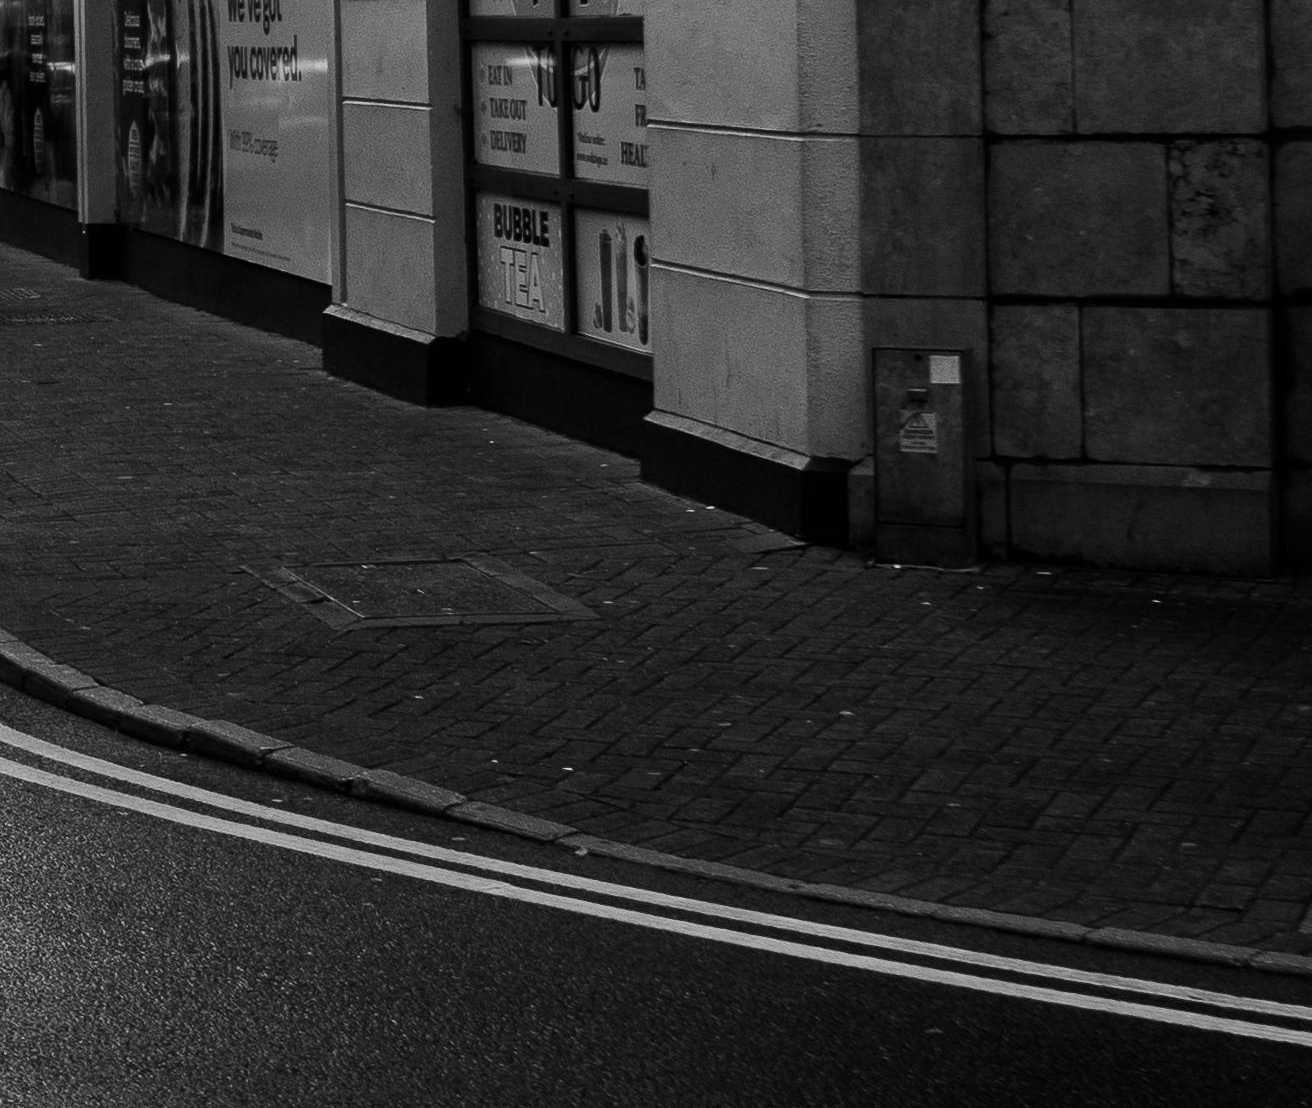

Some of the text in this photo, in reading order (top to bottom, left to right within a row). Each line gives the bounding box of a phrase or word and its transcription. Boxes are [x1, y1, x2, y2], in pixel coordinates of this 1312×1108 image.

[227, 34, 302, 90] you covered.
[487, 64, 513, 87] EAT IN
[489, 97, 527, 121] TAKE OUT
[489, 130, 527, 154] DELIVERY
[493, 203, 550, 248] BUBBLE
[499, 245, 547, 314] TEA
